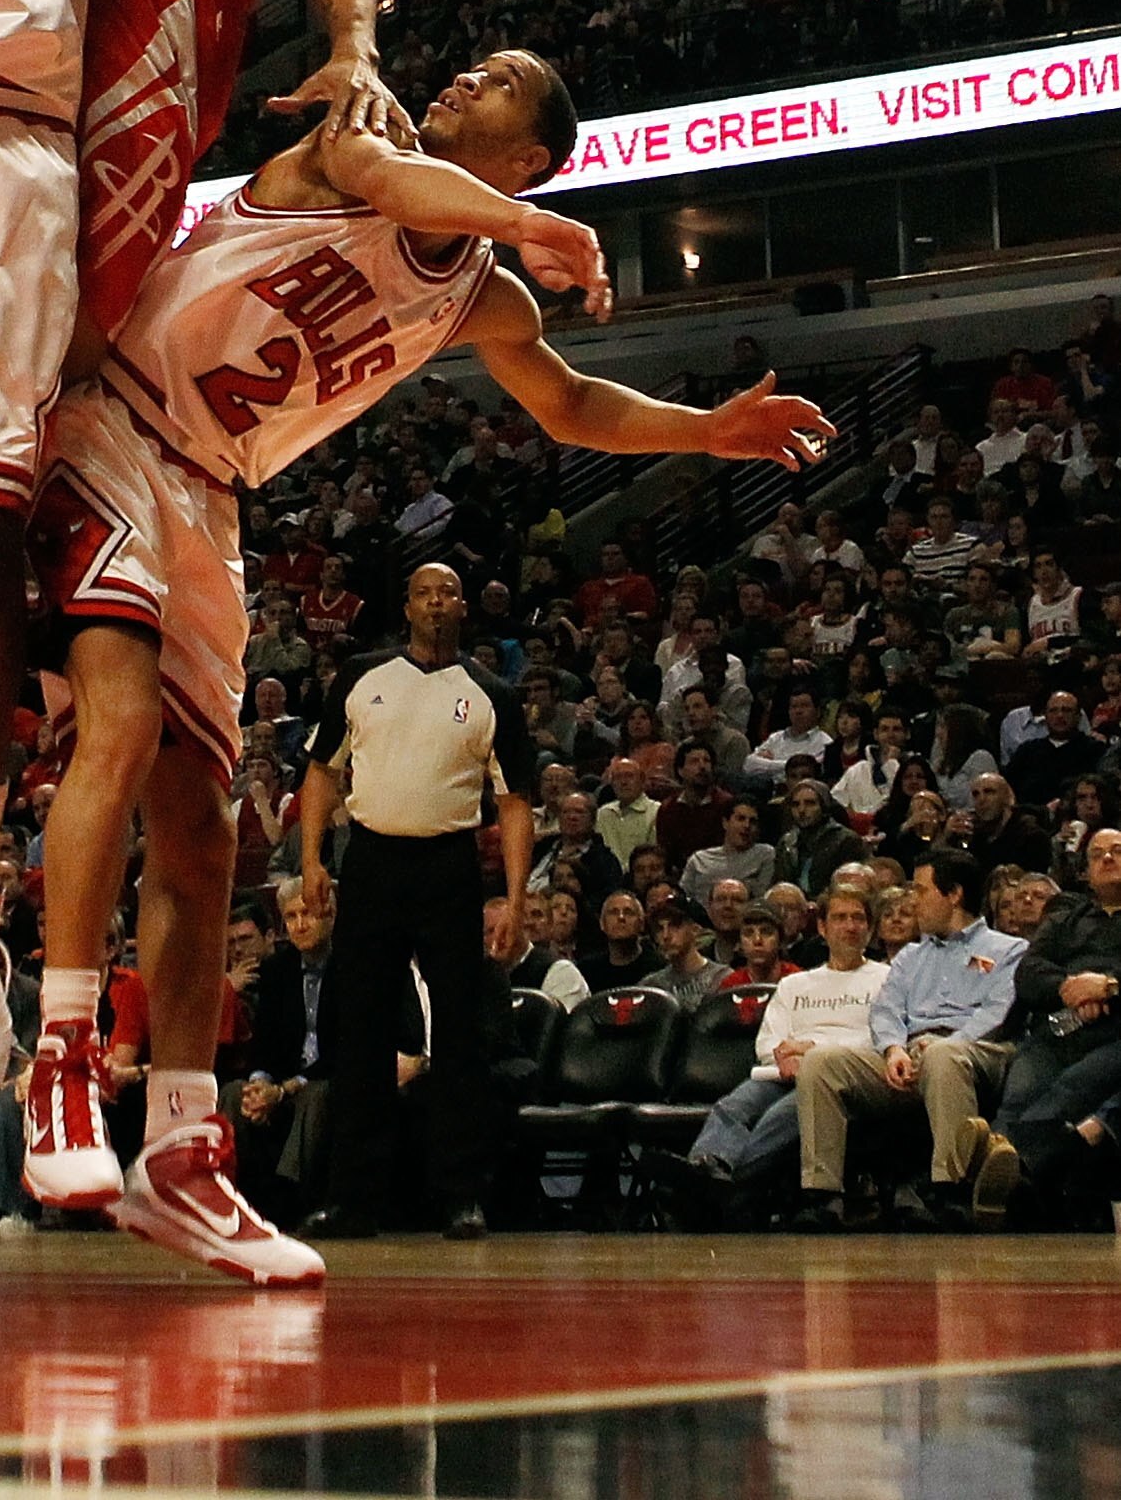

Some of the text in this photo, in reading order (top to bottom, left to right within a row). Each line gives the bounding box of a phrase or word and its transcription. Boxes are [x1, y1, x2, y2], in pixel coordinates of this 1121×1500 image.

[685, 97, 848, 155] GREEN.
[878, 73, 992, 126] VISIT
[1007, 53, 1120, 106] COM
[244, 245, 397, 406] BULLS
[193, 336, 303, 438] 2
